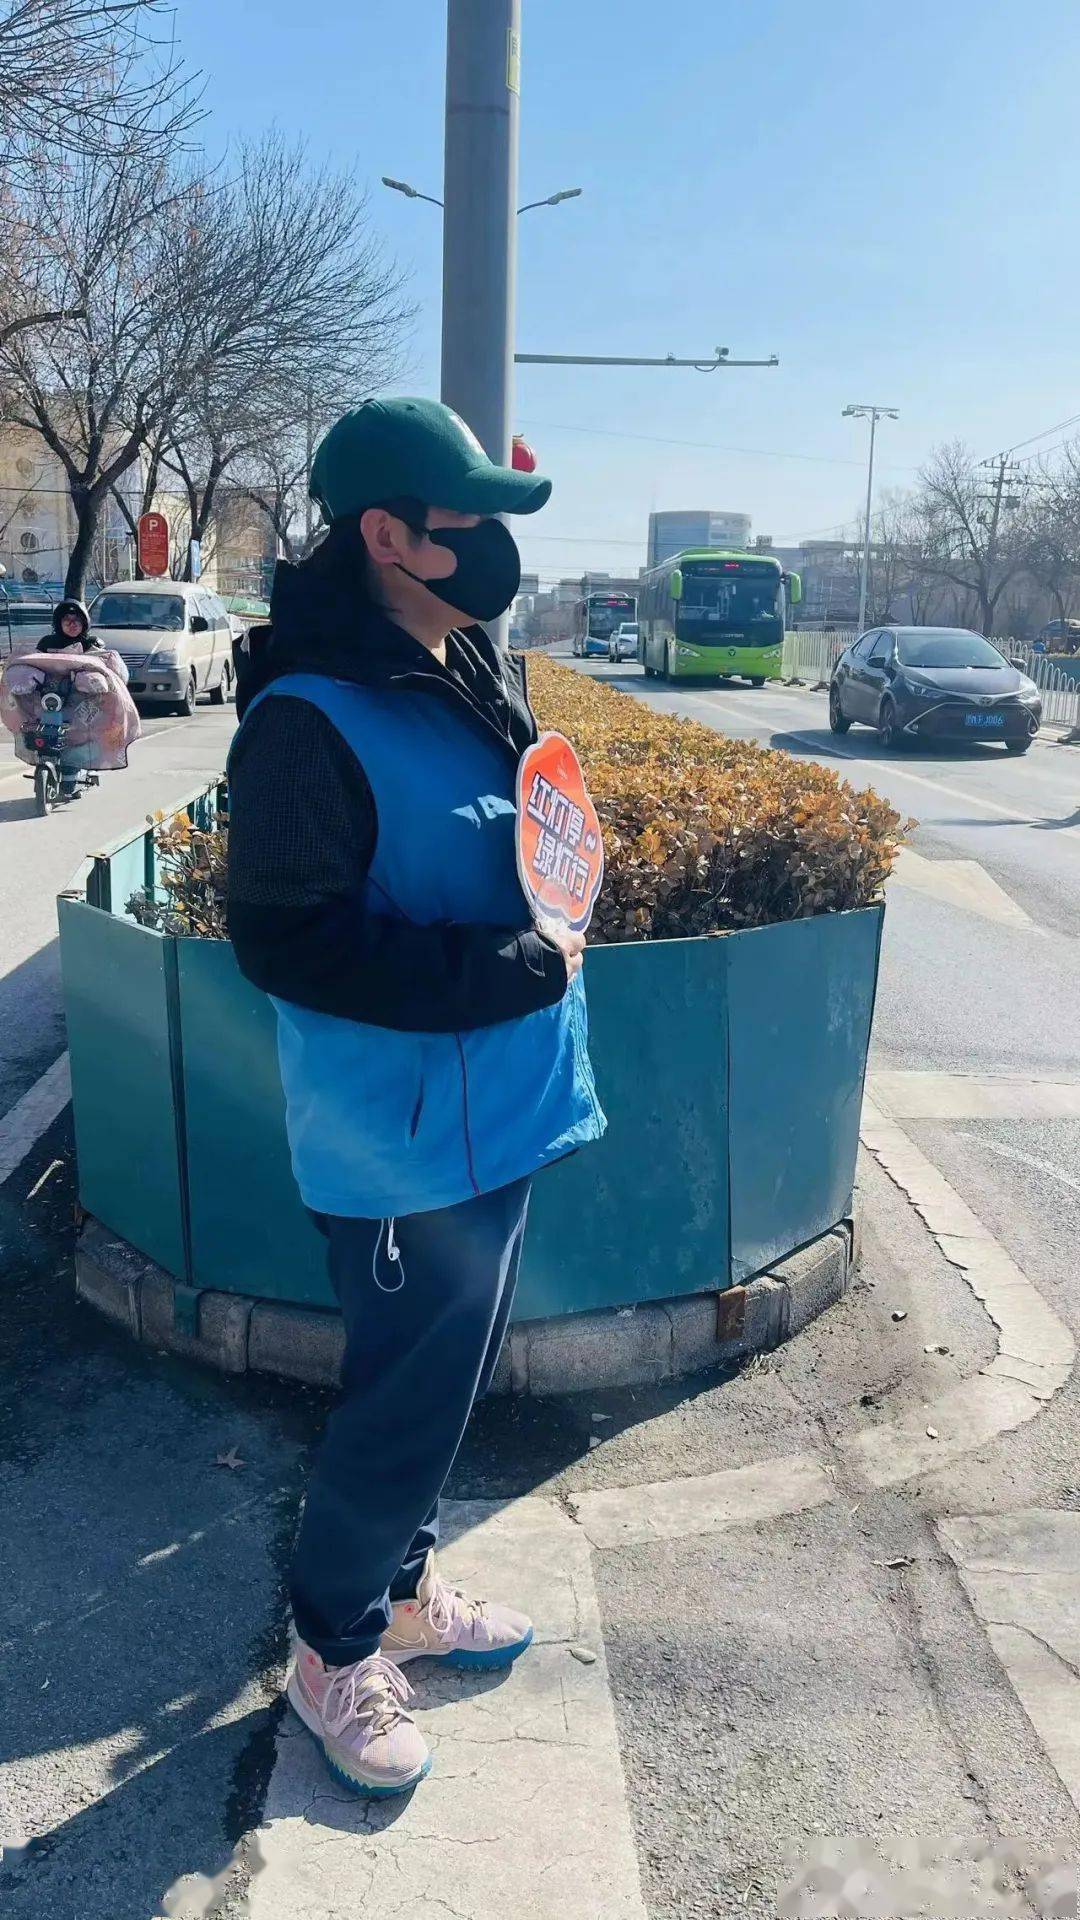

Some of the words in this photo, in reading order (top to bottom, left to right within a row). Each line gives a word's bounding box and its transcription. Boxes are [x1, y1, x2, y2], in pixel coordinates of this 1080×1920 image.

[149, 519, 158, 531] P
[527, 771, 585, 847] 红灯停
[532, 827, 590, 902] 绿灯行
